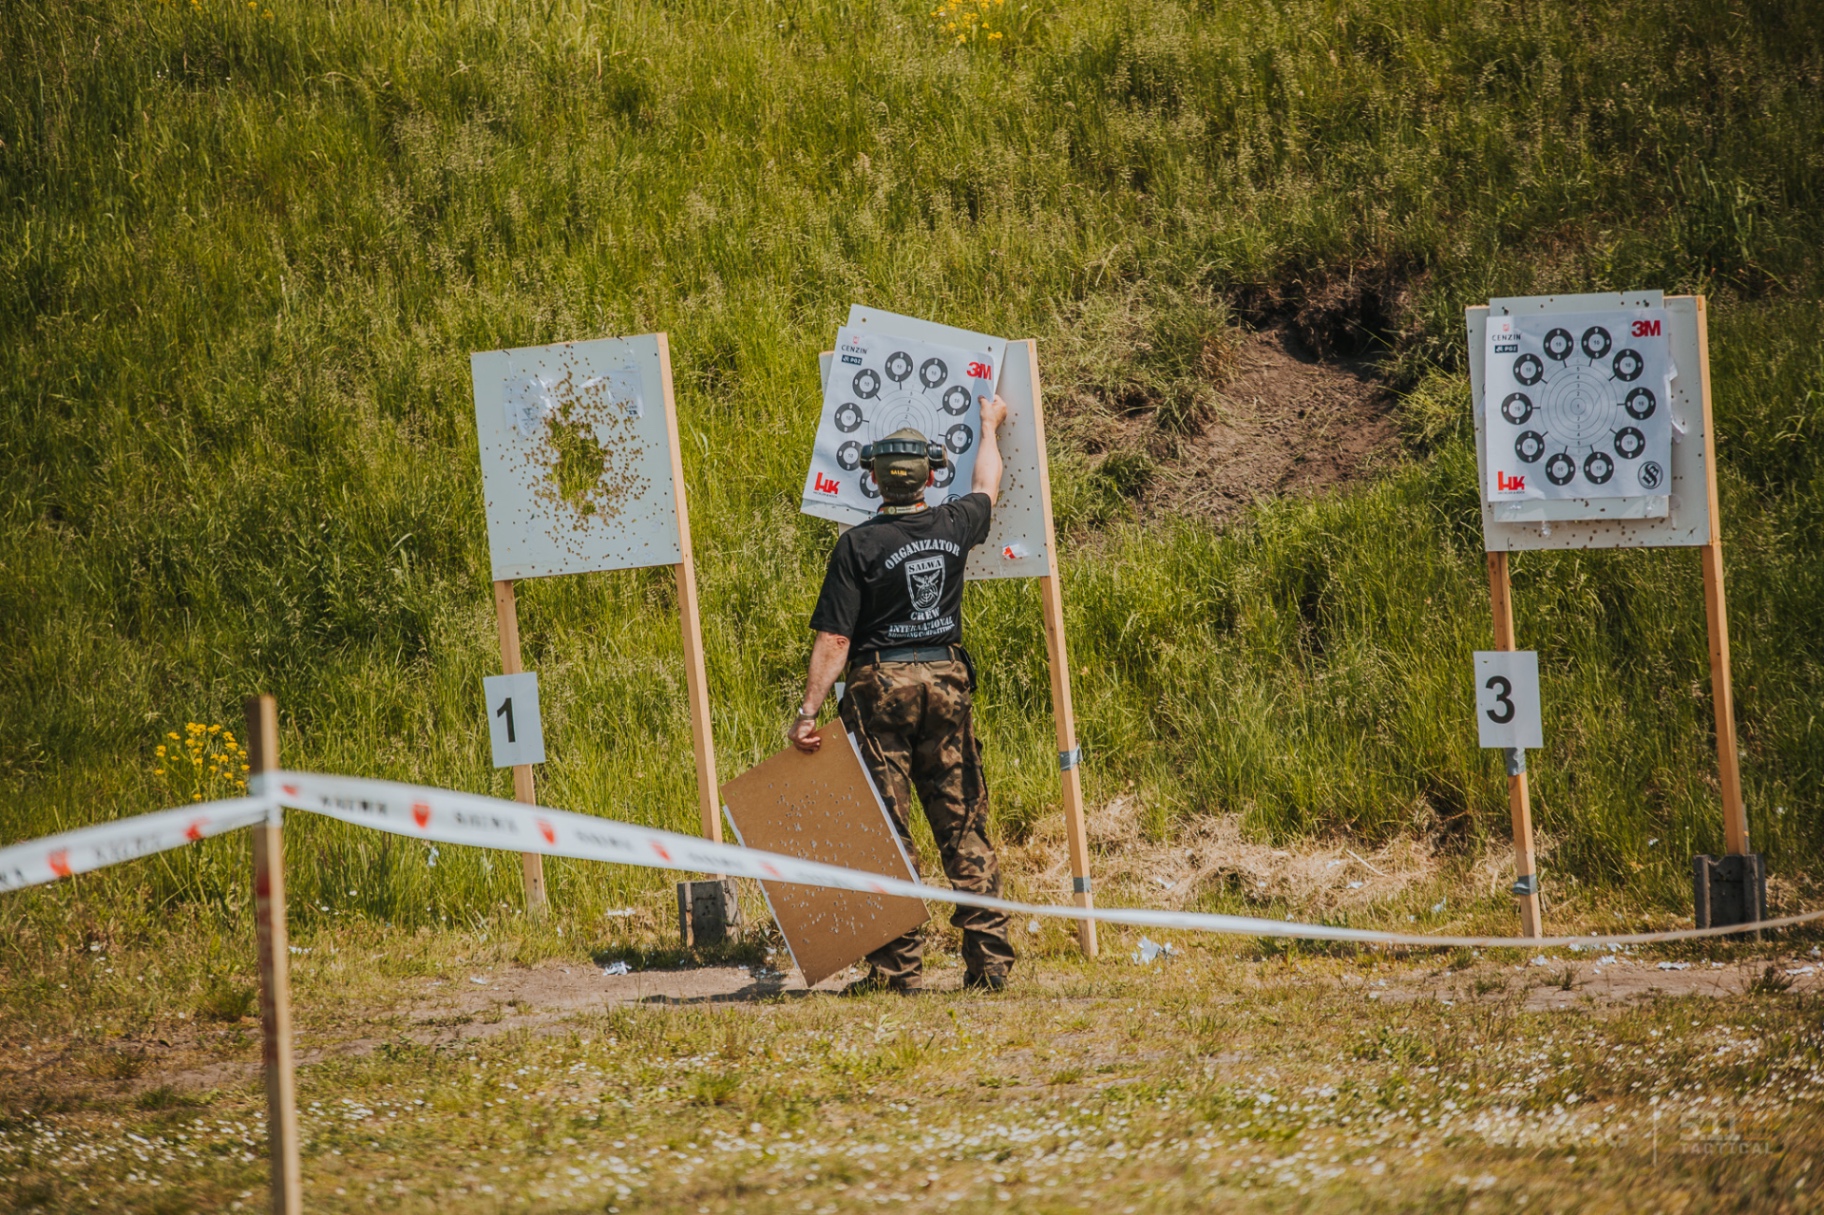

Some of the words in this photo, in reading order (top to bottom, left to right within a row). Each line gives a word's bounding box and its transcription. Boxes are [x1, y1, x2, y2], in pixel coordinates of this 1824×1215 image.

[1631, 320, 1661, 338] 3M
[841, 344, 867, 354] CENZIN
[966, 362, 992, 380] 3M
[884, 539, 960, 569] ORGANIZATOR
[908, 560, 941, 572] SALWA
[910, 607, 940, 620] CREW
[1486, 676, 1515, 724] 3
[497, 697, 516, 743] 1
